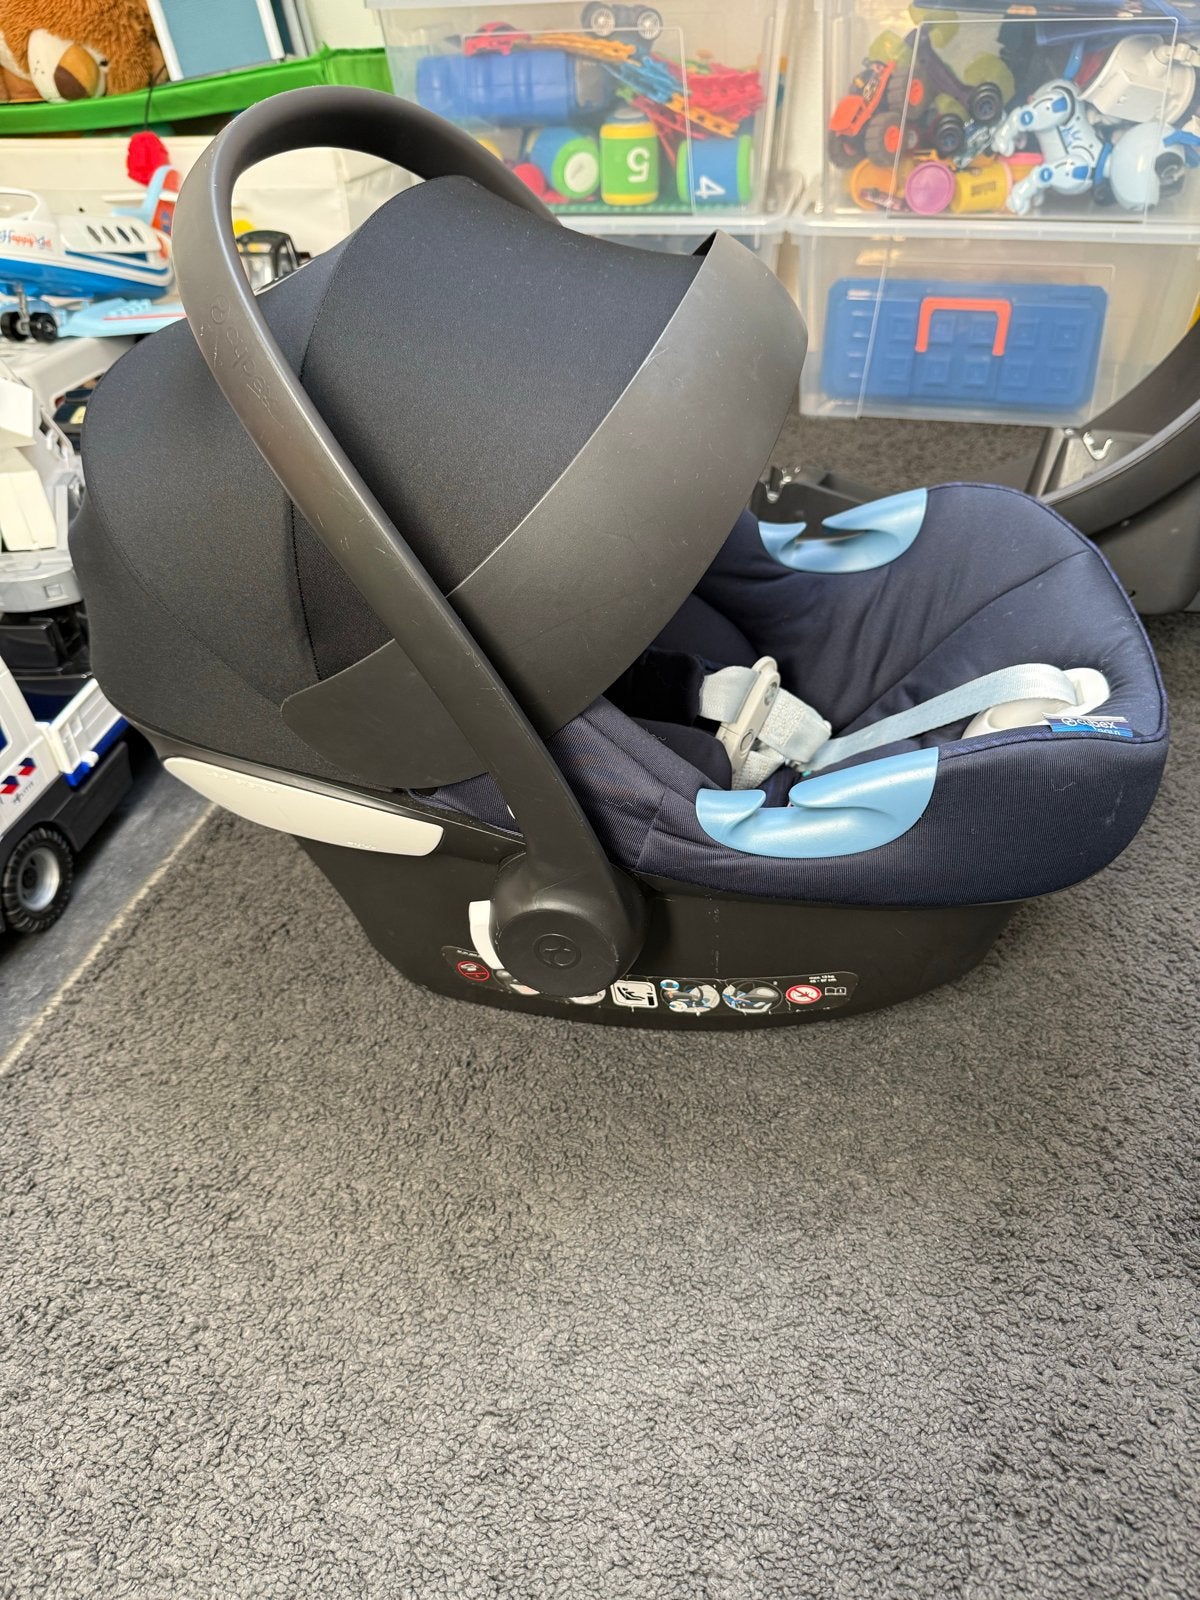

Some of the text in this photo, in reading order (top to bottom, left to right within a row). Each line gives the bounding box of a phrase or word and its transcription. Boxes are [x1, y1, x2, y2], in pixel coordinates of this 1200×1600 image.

[626, 147, 650, 183] 5
[695, 175, 726, 200] 4
[1077, 717, 1118, 731] cybex
